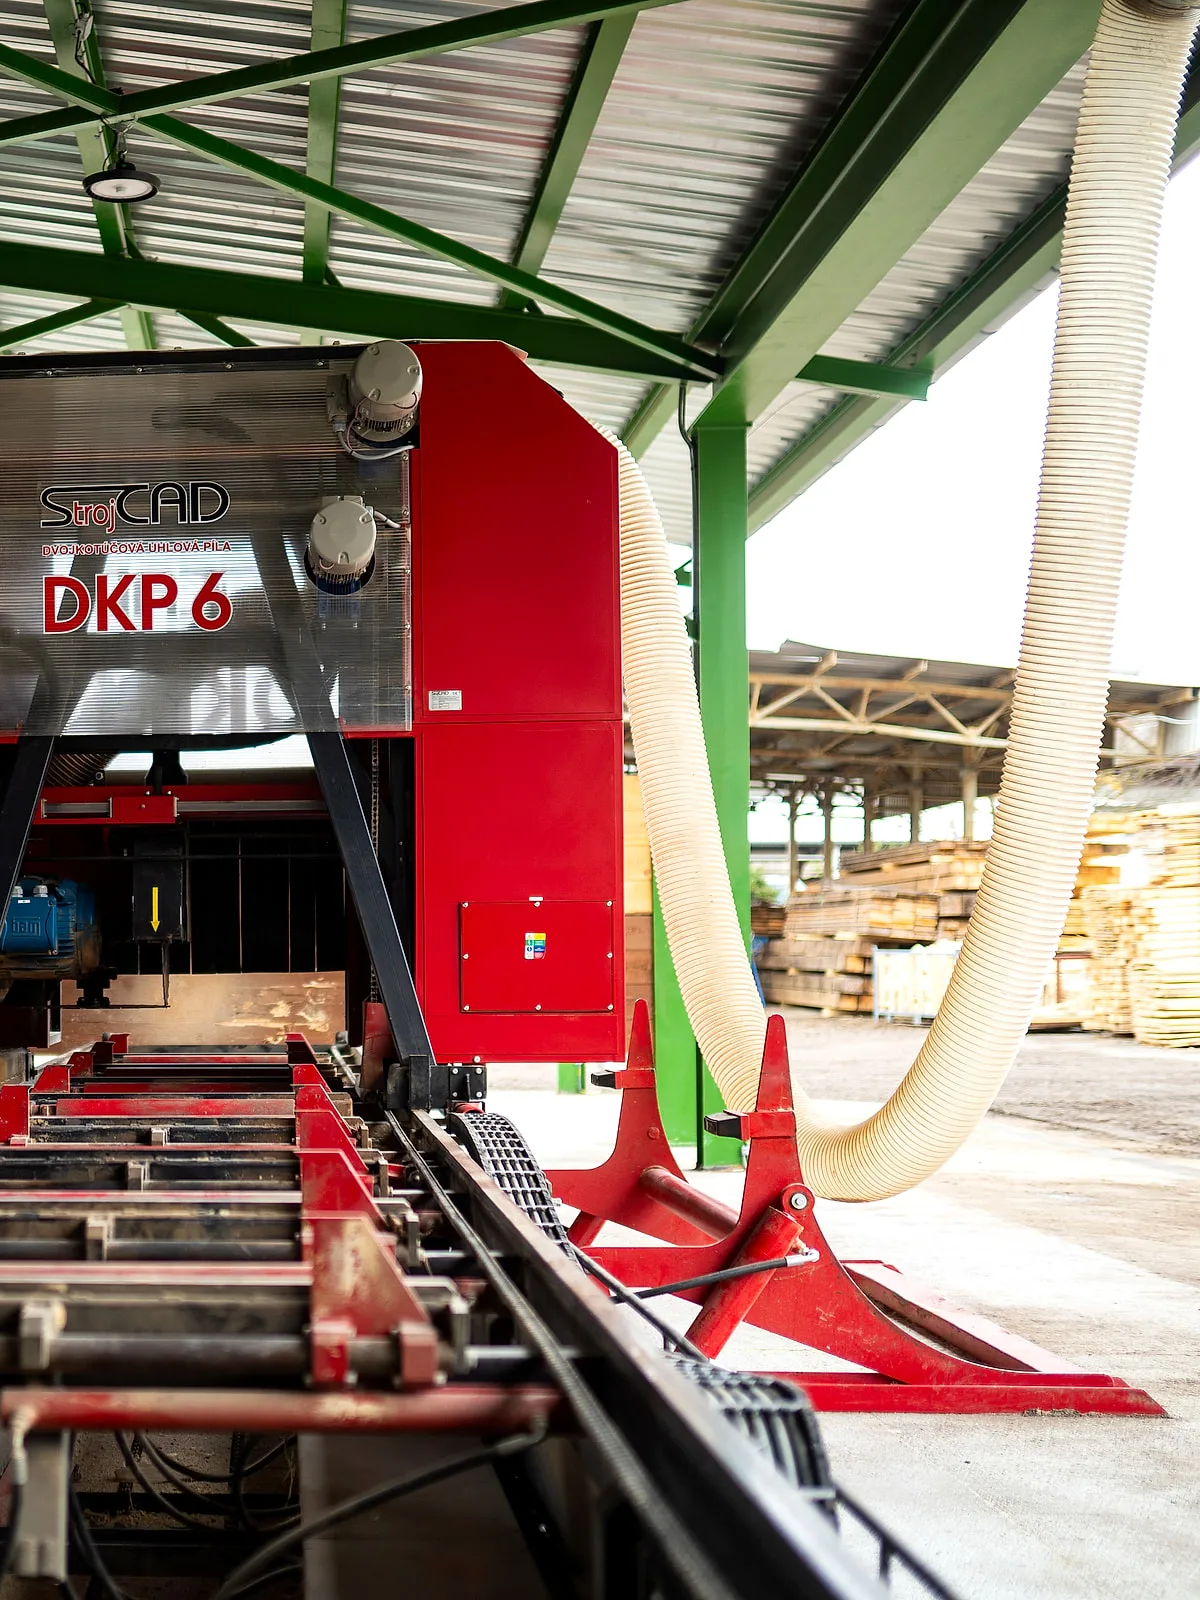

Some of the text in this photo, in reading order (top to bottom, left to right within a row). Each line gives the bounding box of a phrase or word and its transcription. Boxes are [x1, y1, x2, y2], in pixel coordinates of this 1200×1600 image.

[40, 481, 231, 533] StrojCAD
[42, 538, 232, 556] DVOJKOTÚČOVÁ UHLOVÁ PÍLA
[43, 572, 234, 634] DKP 6
